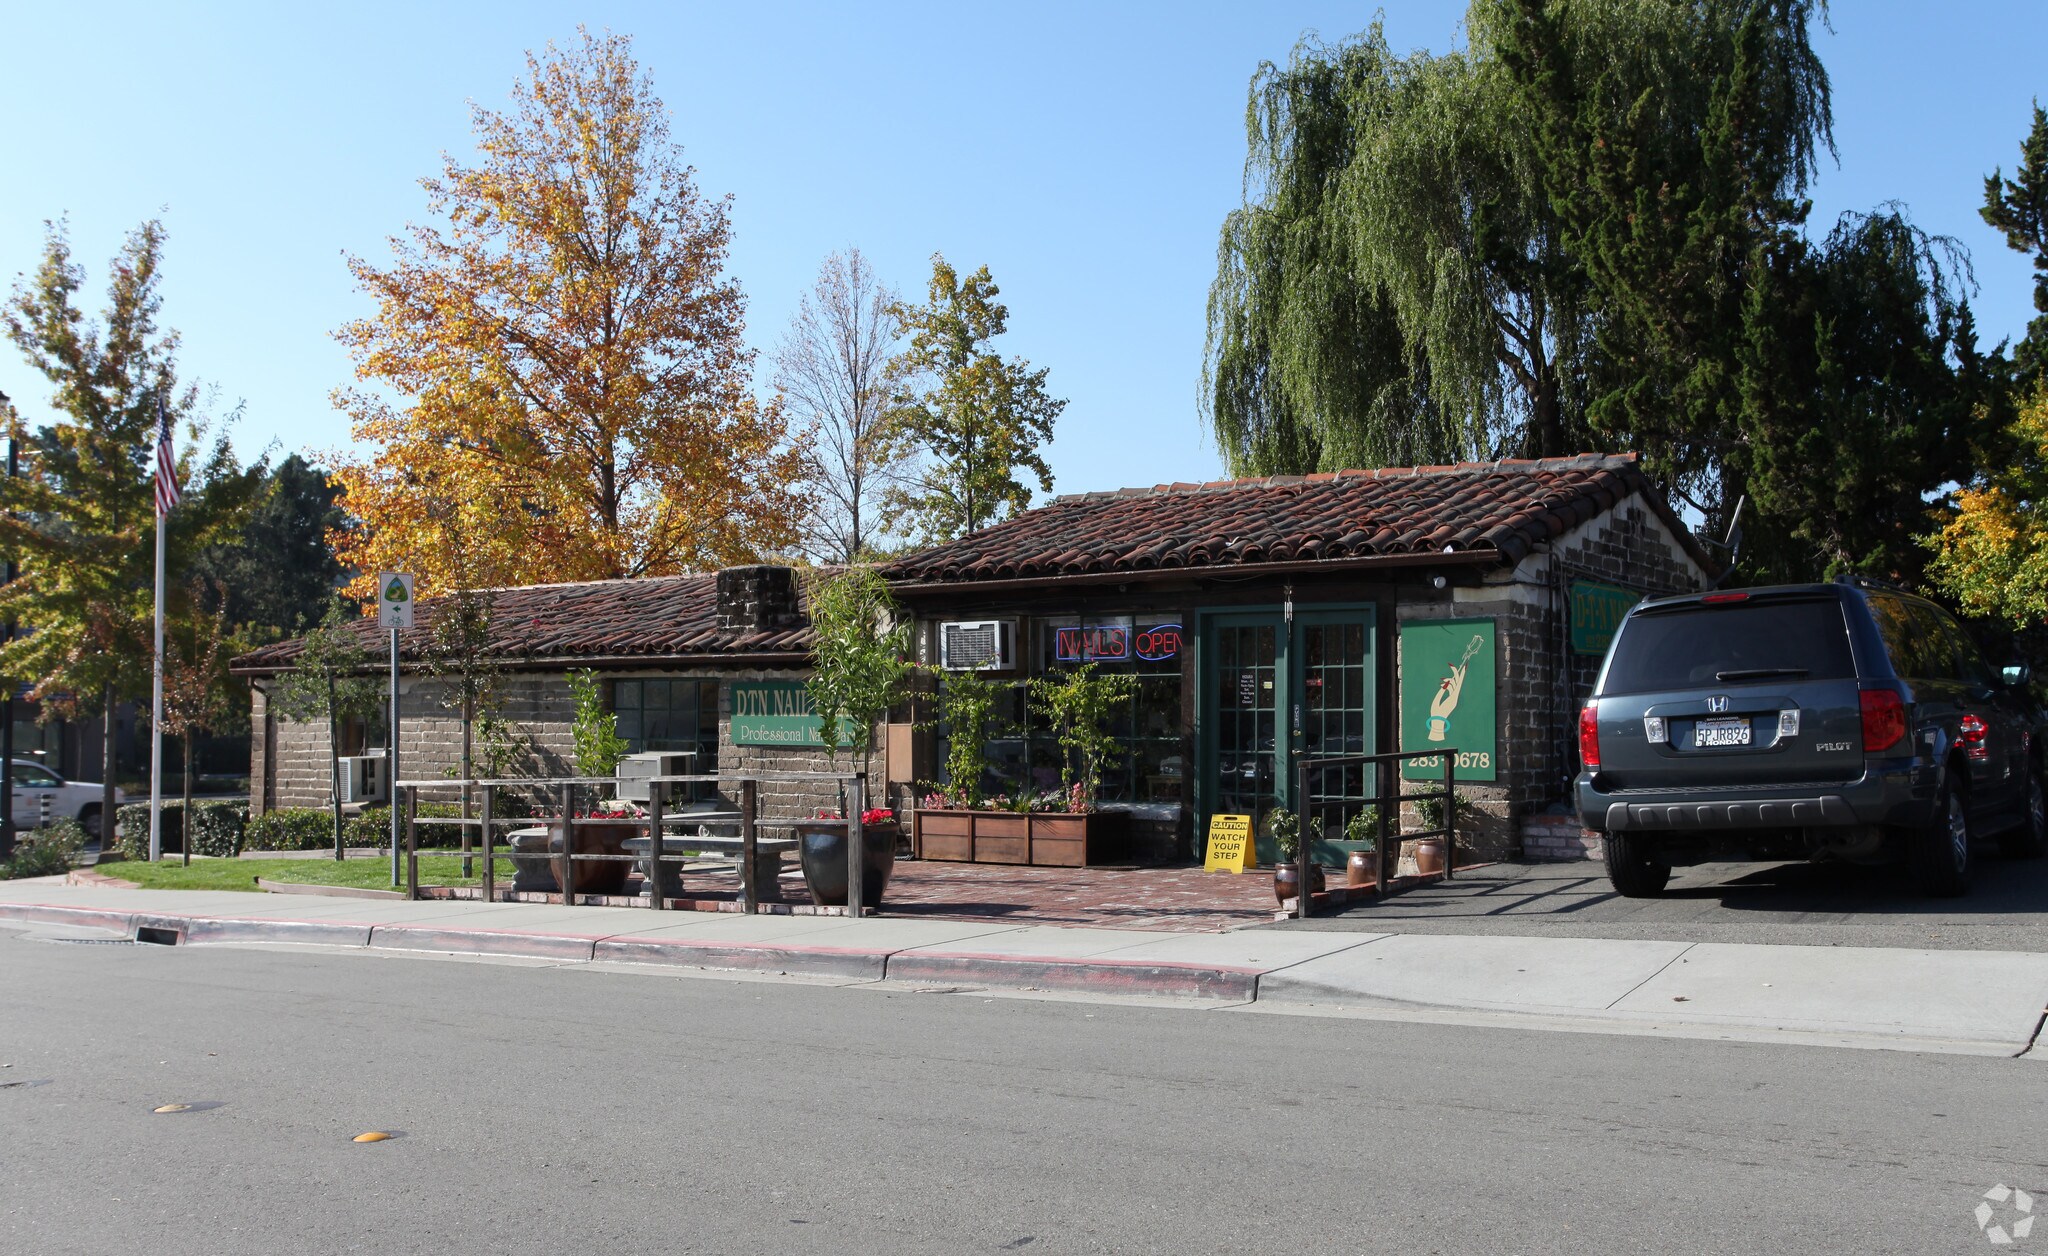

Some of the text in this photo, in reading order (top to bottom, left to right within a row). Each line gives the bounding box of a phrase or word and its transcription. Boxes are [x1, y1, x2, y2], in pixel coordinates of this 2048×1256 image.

[1060, 629, 1125, 655] NAILS
[1136, 632, 1182, 653] OPEN
[736, 690, 768, 716] DTN
[741, 725, 804, 742] Professional
[1698, 727, 1748, 742] 5PJR896
[1816, 742, 1852, 751] PILOT
[1212, 822, 1248, 830] CAUTION
[1211, 833, 1246, 841] WATCH
